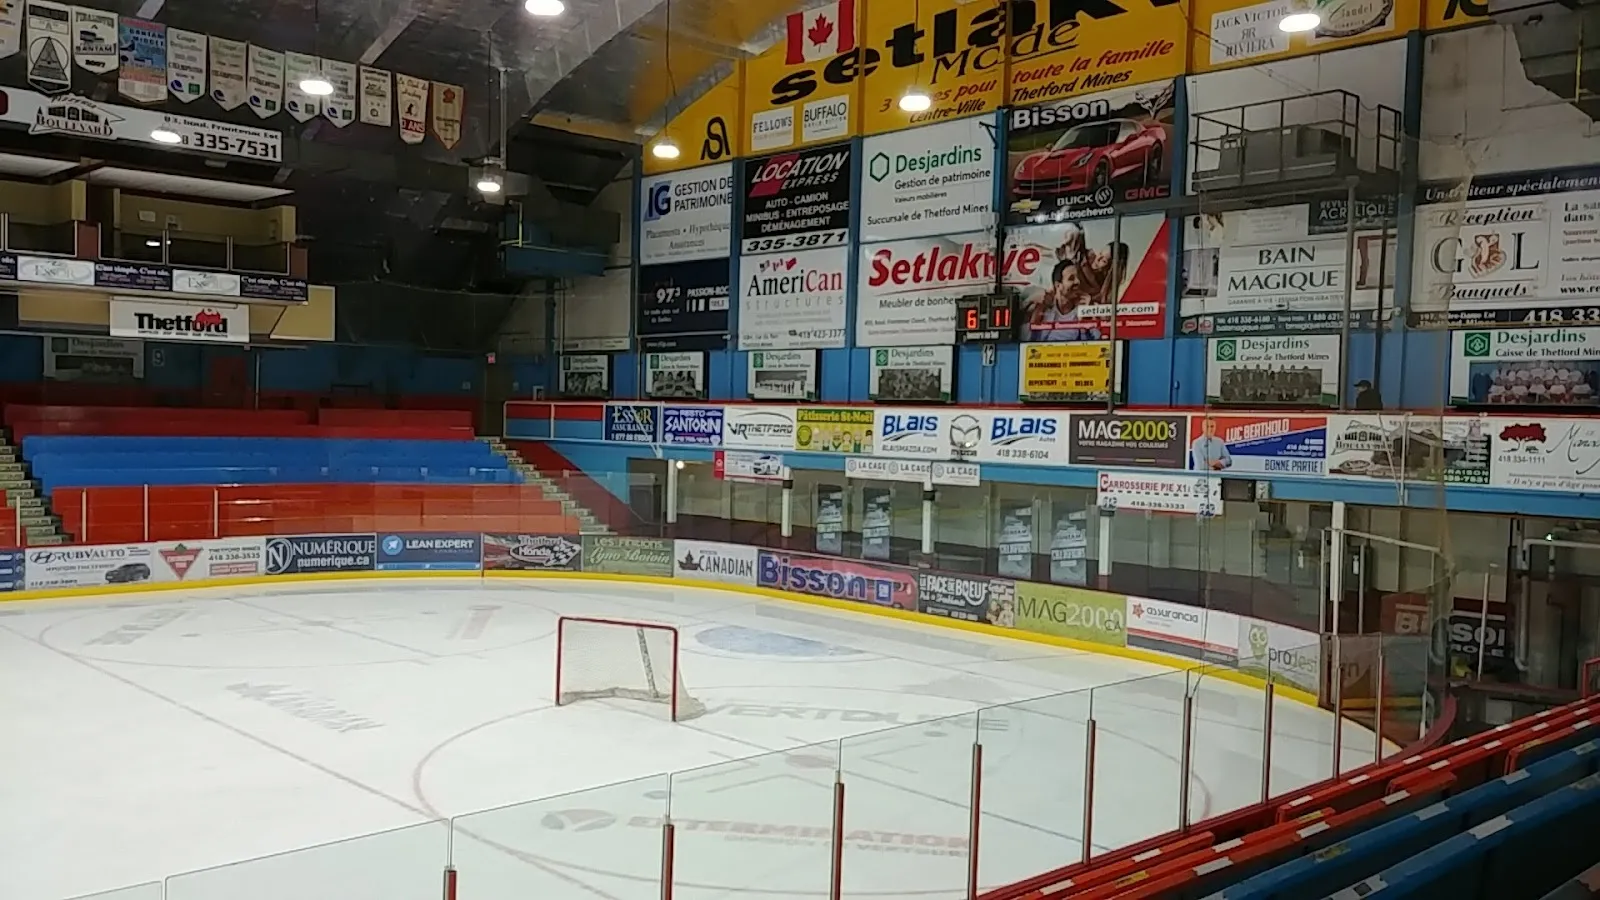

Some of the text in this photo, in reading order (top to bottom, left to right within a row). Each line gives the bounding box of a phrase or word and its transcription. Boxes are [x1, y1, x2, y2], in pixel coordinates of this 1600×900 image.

[1214, 18, 1241, 30] JACK
[930, 19, 1081, 85] Mode
[955, 79, 998, 101] pour
[1011, 64, 1065, 85] toute
[1069, 56, 1092, 73] la
[1096, 39, 1175, 68] famille
[1011, 77, 1076, 102] Thetford
[1080, 69, 1133, 90] Mines
[803, 102, 847, 123] BUFFALO
[1012, 99, 1110, 130] Bisson
[753, 116, 793, 134] FELLOWS
[193, 131, 278, 159] 335-7531
[751, 150, 850, 184] LOCATION
[895, 144, 983, 174] Desjardins
[674, 176, 733, 197] GESTION DE
[781, 170, 840, 190] EXPRESS
[894, 168, 992, 190] Gestion de patrimoine
[649, 184, 672, 218] IG
[674, 192, 733, 213] PATRIMOINE
[765, 191, 830, 210] AUTO CAMION
[1056, 184, 1170, 207] BUICK GMC
[1425, 187, 1447, 201] Un
[745, 200, 850, 223] MINIBUS ENTREPOSAGE
[867, 203, 990, 226] Succursale de Thetford Mines
[760, 215, 832, 234] DÉMÉNAGEMENT
[746, 230, 847, 253] 335-3871
[1258, 246, 1316, 266] BAIN
[1431, 231, 1540, 274] G L
[746, 268, 843, 297] AmeriCan
[1228, 270, 1339, 292] MAGIQUE
[915, 297, 926, 307] de
[927, 295, 955, 307] bonhe
[134, 313, 229, 332] Thetford
[966, 309, 978, 329] 6
[995, 307, 1010, 327] 11
[1523, 308, 1564, 325] 418
[1241, 337, 1311, 353] Desjardins
[1497, 329, 1587, 347] Desjardins
[891, 349, 934, 360] Desjardins
[1495, 349, 1524, 358] Caisse
[1526, 348, 1538, 357] de
[1541, 347, 1580, 357] Thetford
[1225, 418, 1290, 442] LUC BERTHOLD
[868, 461, 886, 471] CAGE
[911, 463, 931, 473] CAGE
[1264, 459, 1318, 473] BONNE PARTIE
[1498, 455, 1511, 463] 418
[957, 467, 978, 476] CAGE
[1100, 473, 1175, 492] CARROSSERIE PIE
[293, 538, 375, 556] NUMÉRIQUE
[405, 539, 475, 549] LEAN EXPERT
[518, 546, 552, 557] Honda
[296, 554, 370, 569] numerique.ca
[699, 555, 754, 577] CANADIAN
[759, 555, 866, 600] Bisson
[927, 574, 947, 594] FACE
[1146, 605, 1199, 624] assurancia
